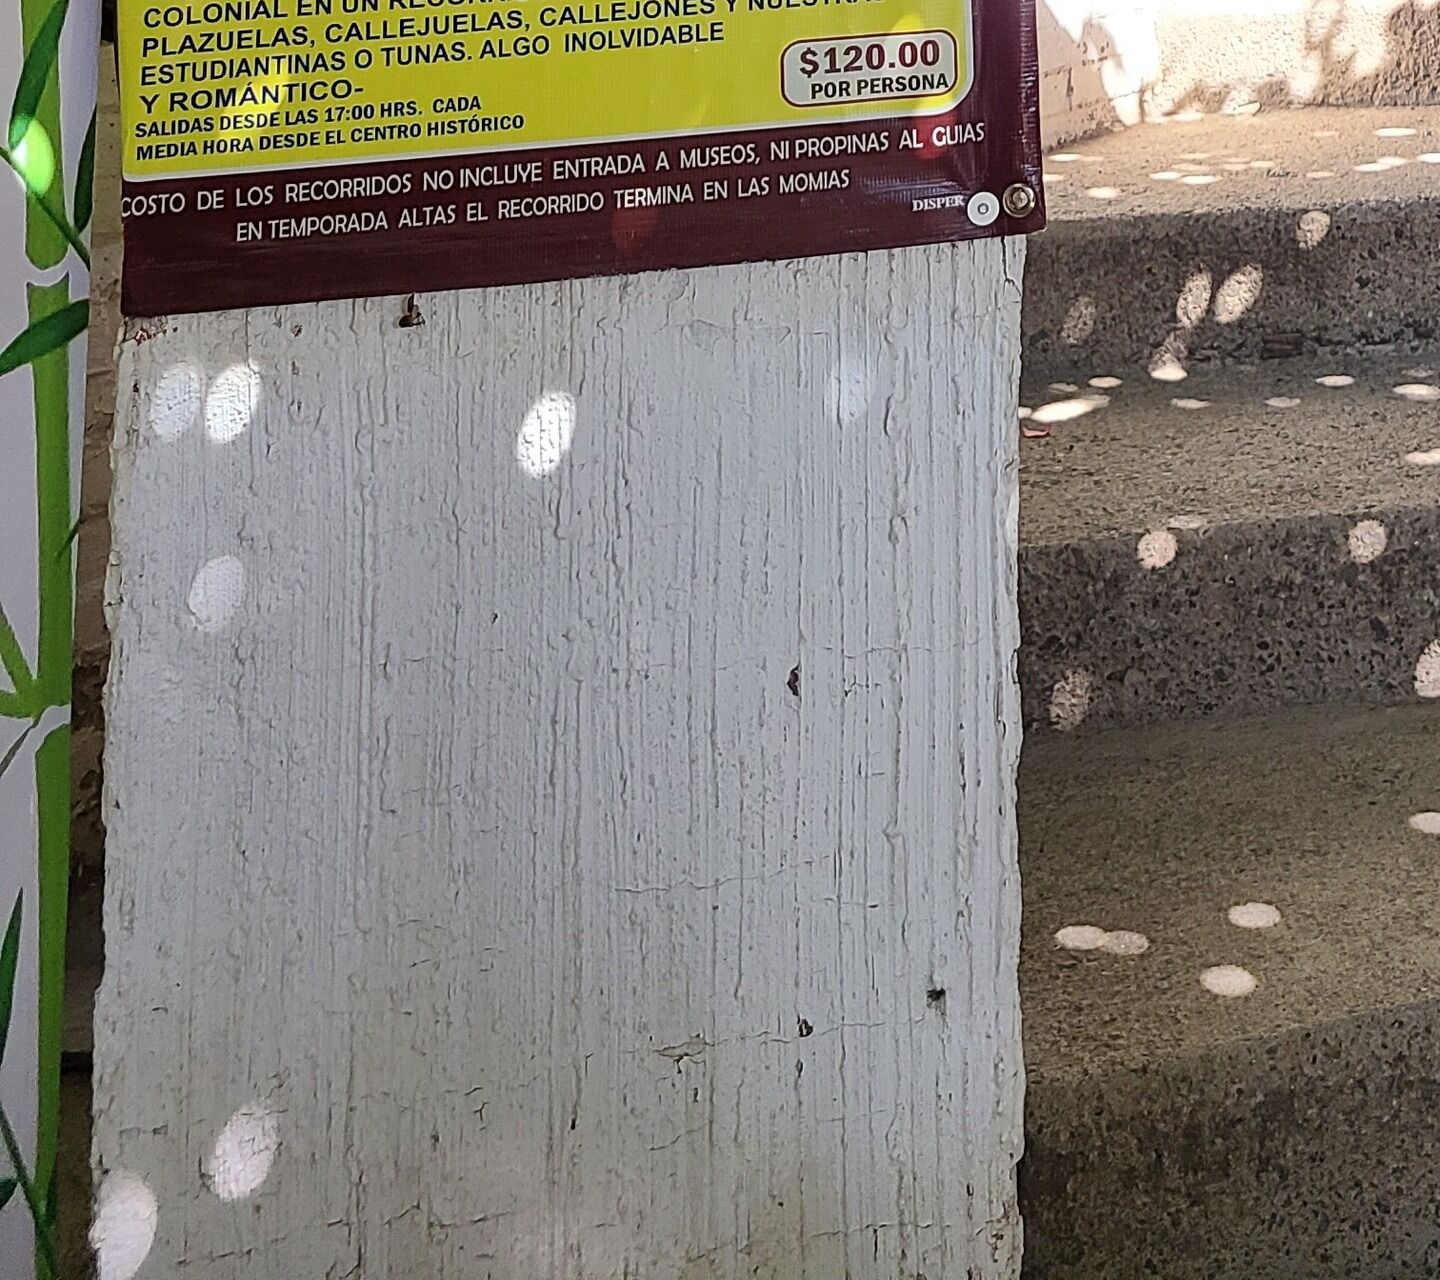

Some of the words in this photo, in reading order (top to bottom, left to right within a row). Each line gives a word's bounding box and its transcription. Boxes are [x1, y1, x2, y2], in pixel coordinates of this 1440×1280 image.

[800, 39, 940, 78] $120.00
[139, 94, 160, 114] Y
[169, 78, 364, 112] ROMÁNTICO-
[810, 76, 851, 99] POR
[856, 72, 949, 95] PERSONA
[135, 118, 214, 137] SALIDAS
[219, 113, 281, 131] DESDE
[285, 109, 318, 125] LAS
[324, 106, 375, 122] 17:00
[380, 101, 423, 118] HRS.
[432, 95, 481, 114] CADA
[236, 221, 263, 241] EN
[268, 209, 389, 239] TEMPORADA
[398, 205, 456, 229] ALTAS
[466, 202, 489, 222] EL
[498, 191, 604, 219] RECORRIDO
[613, 184, 694, 209] TERMINA
[703, 182, 728, 201] EN
[737, 177, 770, 199] LAS
[779, 169, 850, 193] MOMIAS
